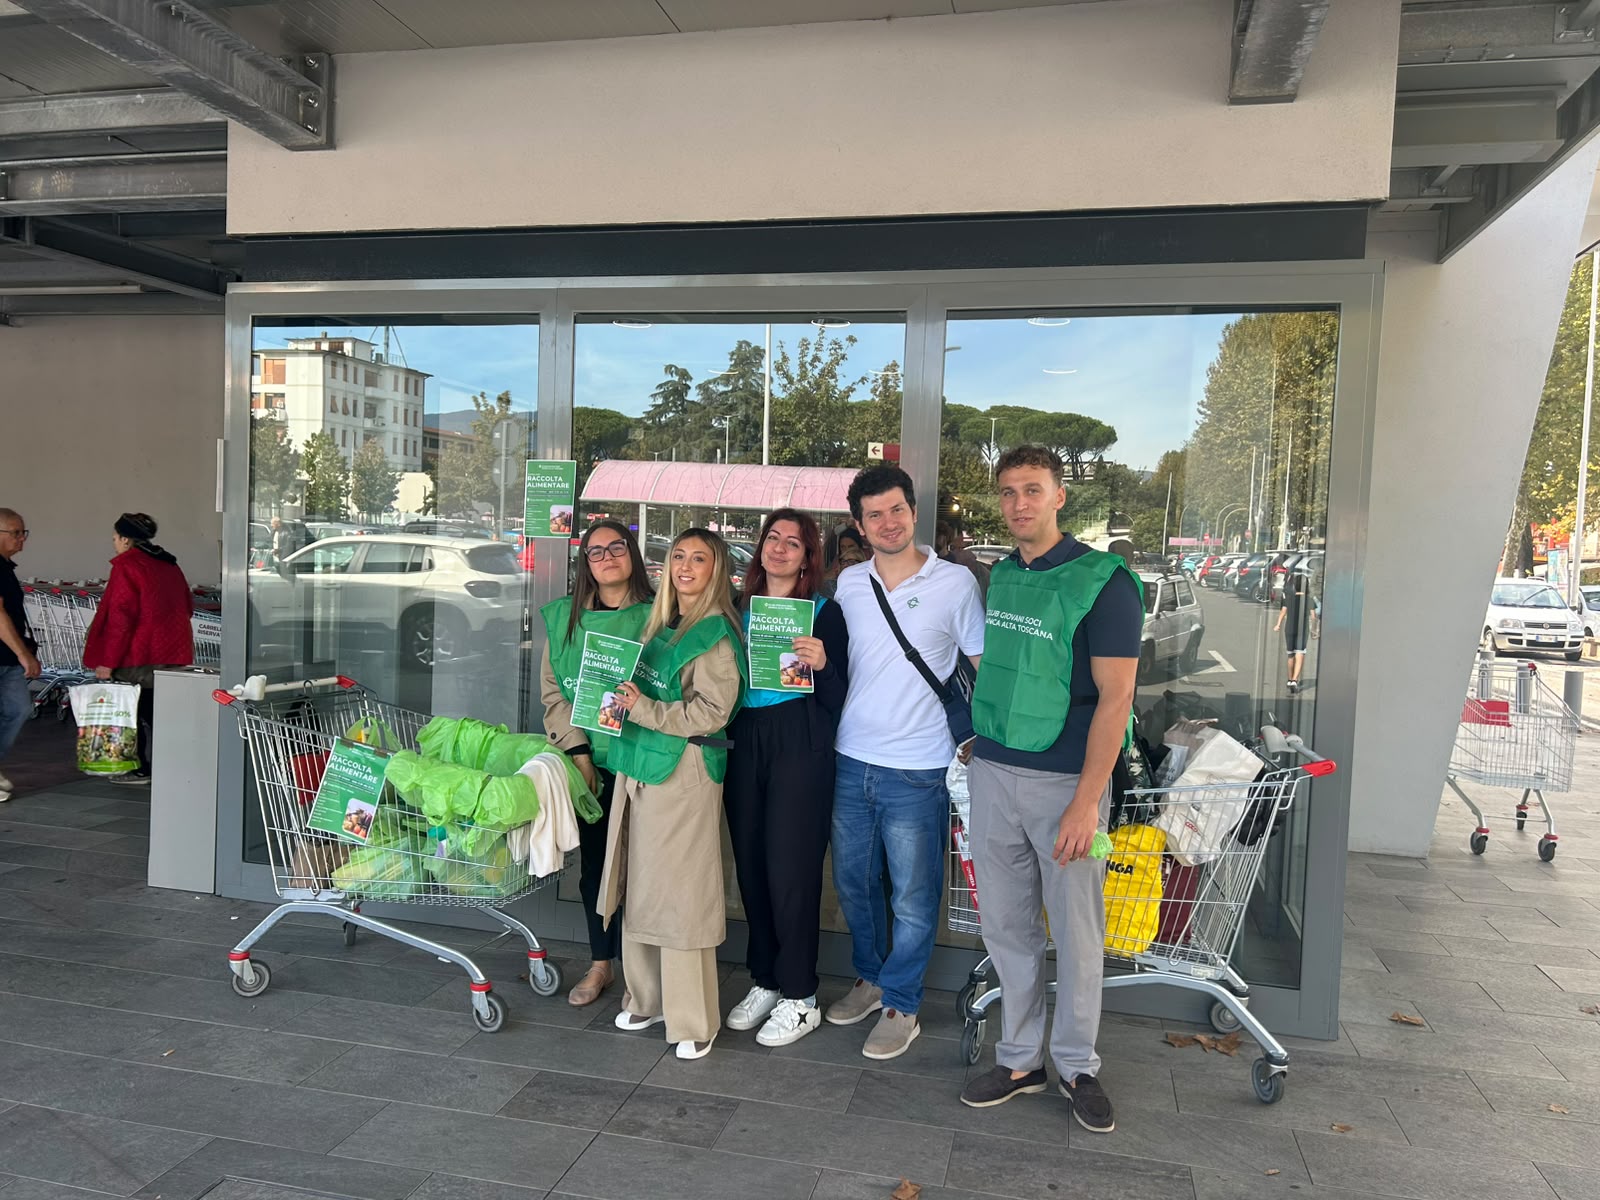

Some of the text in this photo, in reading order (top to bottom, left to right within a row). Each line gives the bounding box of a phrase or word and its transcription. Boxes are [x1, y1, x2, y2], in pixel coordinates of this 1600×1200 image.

[751, 615, 795, 625] RACCOLTA
[1000, 611, 1025, 623] GIOVANI
[1025, 616, 1042, 628] SOCI
[197, 629, 222, 638] RISERVA
[751, 623, 804, 634] ALIMENTARE
[1001, 621, 1017, 631] ALTA
[1017, 624, 1053, 641] TOSCANA
[584, 650, 619, 665] RACCOLTA
[583, 658, 626, 675] ALIMENTARE
[331, 754, 372, 774] RACCOLTA
[328, 762, 379, 784] ALIMENTARE
